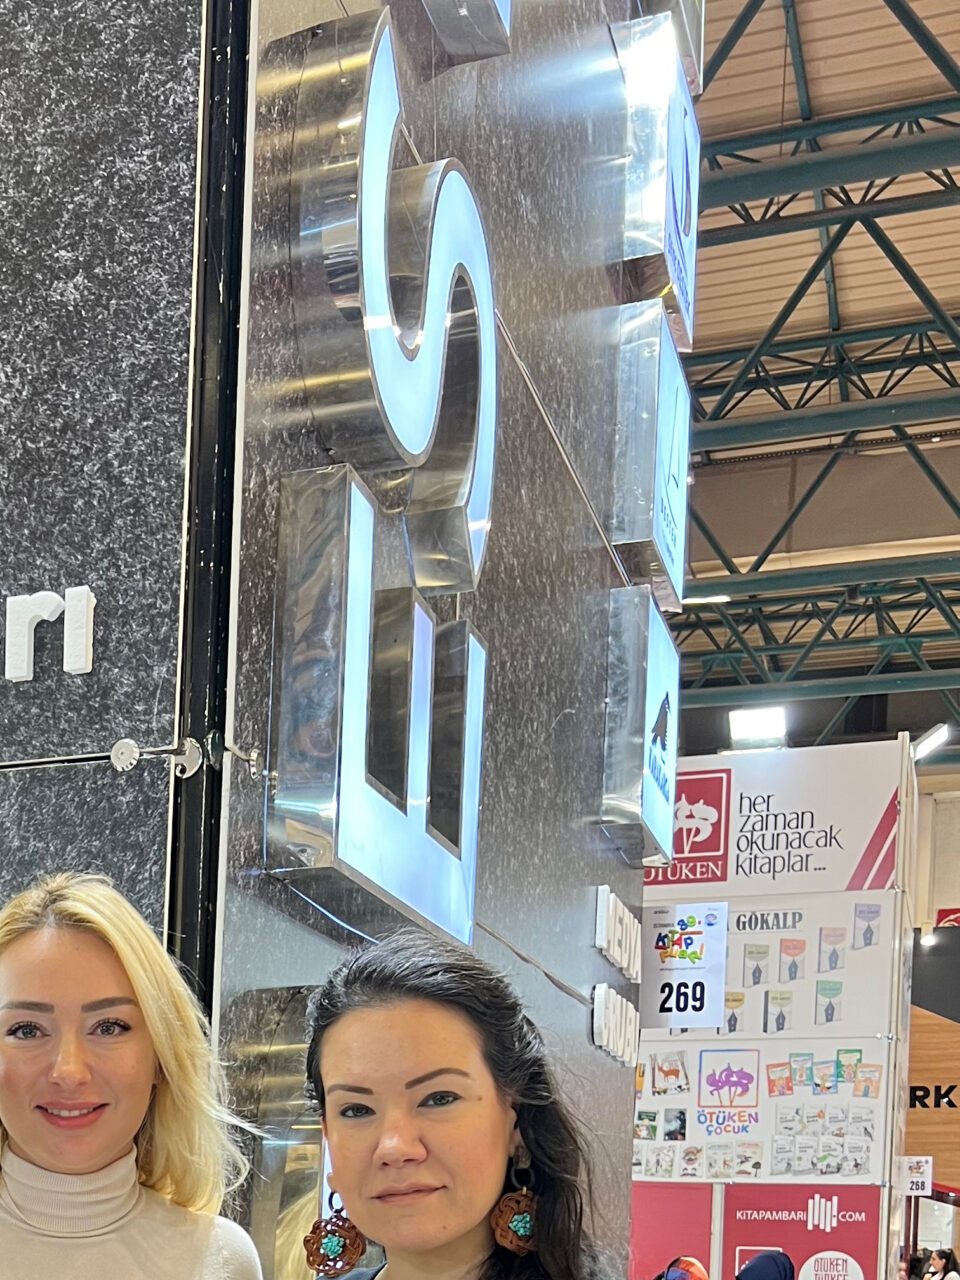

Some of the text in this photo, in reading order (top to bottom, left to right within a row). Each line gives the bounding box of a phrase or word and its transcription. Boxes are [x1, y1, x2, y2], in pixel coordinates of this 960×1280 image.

[739, 792, 775, 814] her
[739, 810, 814, 833] zaman
[736, 825, 844, 855] okunacak
[735, 851, 827, 880] kitaplar...
[736, 911, 803, 931] GÖKALP
[658, 981, 706, 1013] 269
[697, 1110, 759, 1125] ÖTÜKEN
[706, 1124, 749, 1136] ÇOCUK
[909, 1180, 926, 1191] 268
